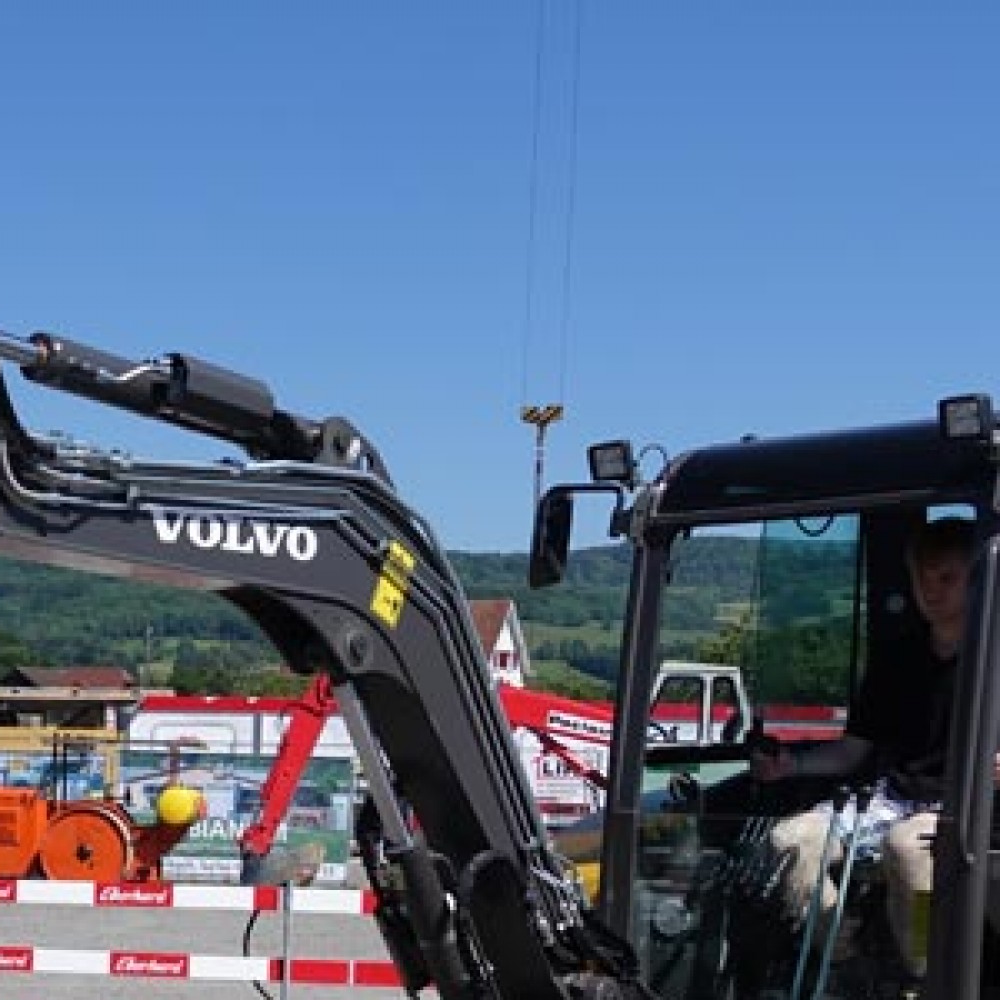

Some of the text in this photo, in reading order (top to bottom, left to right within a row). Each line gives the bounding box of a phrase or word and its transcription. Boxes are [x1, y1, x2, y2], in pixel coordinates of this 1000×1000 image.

[153, 510, 318, 561] VOLVO
[100, 886, 168, 903] Eberhard
[116, 956, 185, 973] Eberhard
